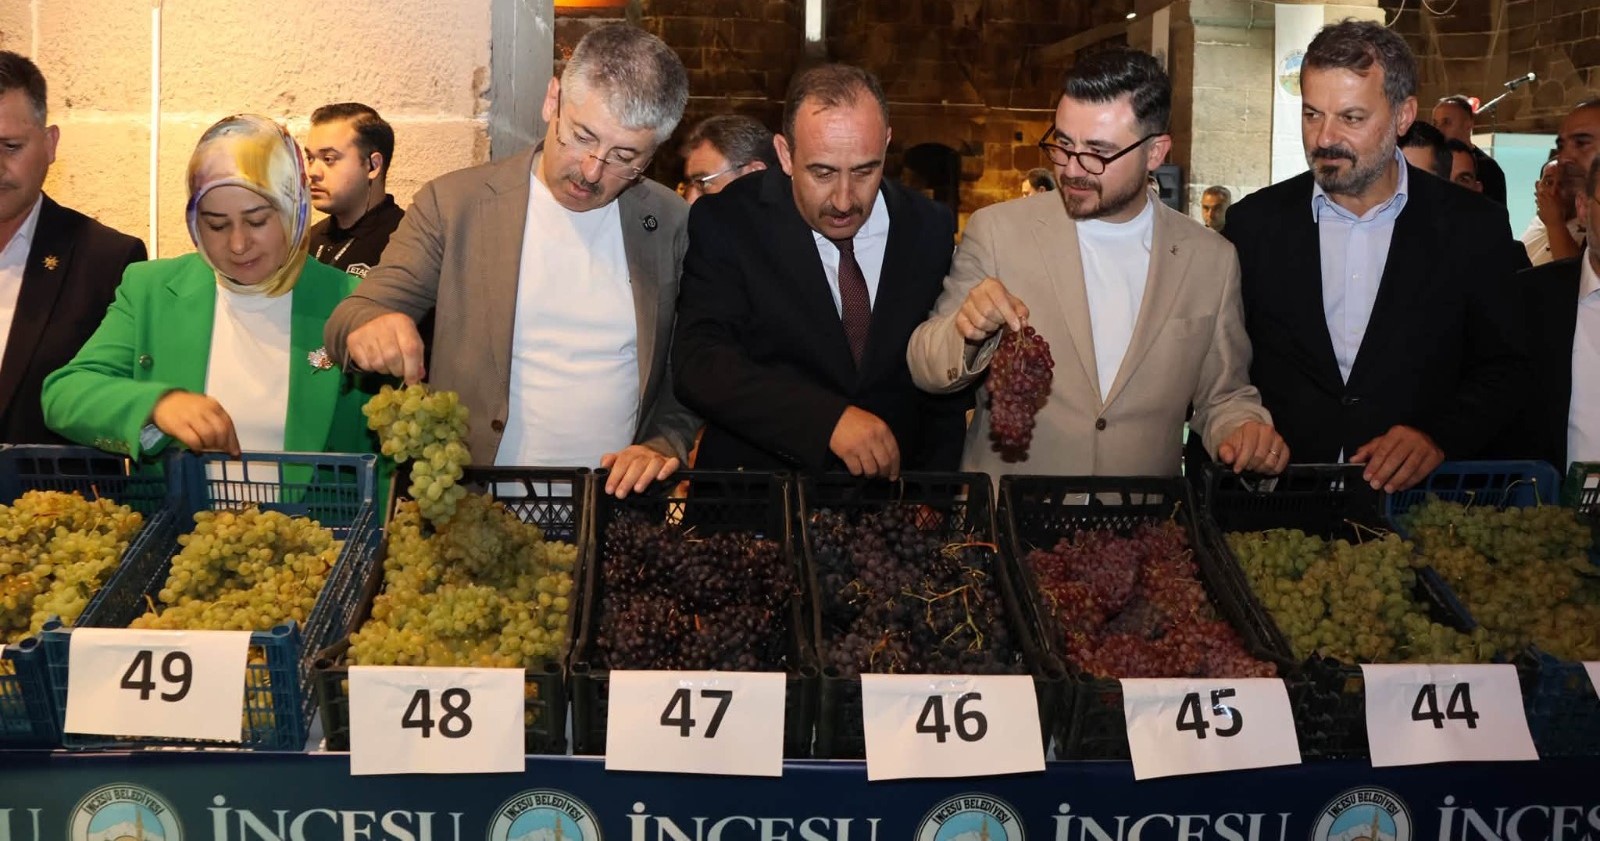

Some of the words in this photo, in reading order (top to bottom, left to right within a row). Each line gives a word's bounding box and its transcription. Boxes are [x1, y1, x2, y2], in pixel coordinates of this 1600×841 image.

[120, 650, 193, 703] 49
[401, 687, 473, 739] 48
[660, 688, 733, 739] 47
[915, 692, 988, 743] 46
[1175, 688, 1243, 740] 45
[1411, 682, 1480, 730] 44
[206, 794, 464, 841] İNCESU
